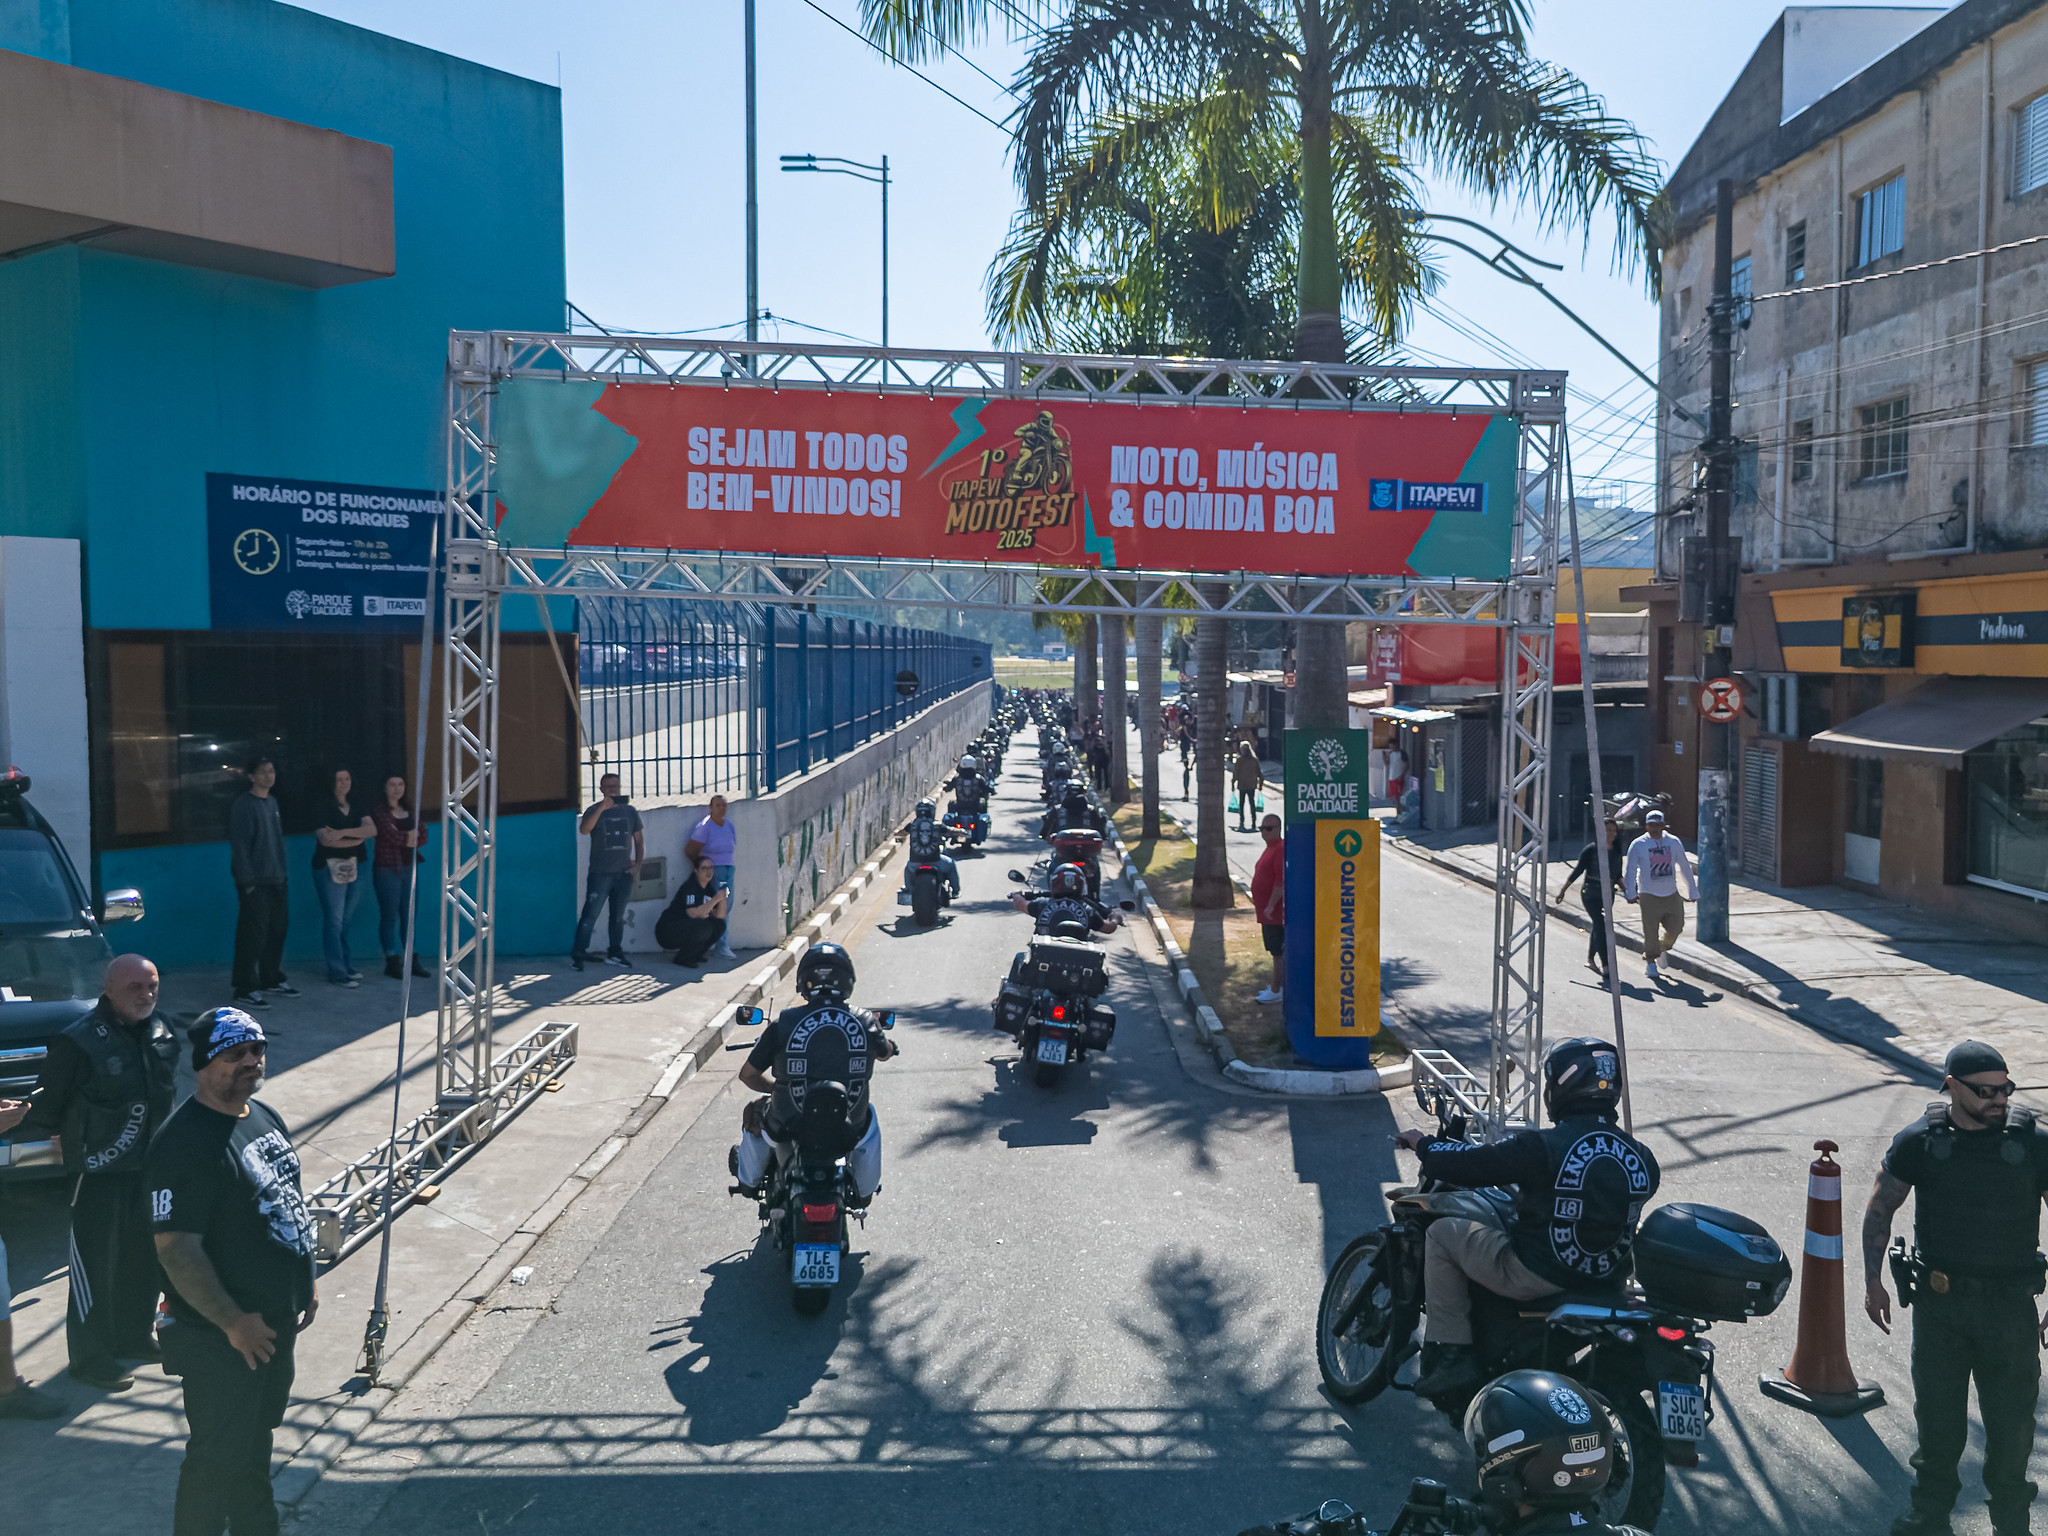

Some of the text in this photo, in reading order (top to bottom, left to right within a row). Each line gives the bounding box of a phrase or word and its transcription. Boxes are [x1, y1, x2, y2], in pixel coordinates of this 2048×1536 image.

[688, 426, 908, 473] SEJAM TODOS
[1110, 441, 1339, 492] MOTO, MÚSICA
[687, 472, 901, 518] BEM-VINDOS!
[950, 478, 1002, 500] ITAPEVI
[1409, 486, 1476, 503] ITAPEVI
[233, 485, 447, 516] HORÁRIO DE FUNCIONAMEN
[1109, 489, 1336, 534] & COMIDA BOA
[302, 508, 410, 529] DOS PARQUES
[944, 493, 1076, 535] MOTOFEST
[996, 528, 1034, 550] 2025
[312, 594, 352, 606] PARQUE
[387, 601, 423, 610] ITAPEVI
[1297, 783, 1358, 800] PARQUE
[1297, 800, 1358, 813] DACIDADE
[1340, 860, 1356, 1027] ESTACIONAMENTO
[791, 1011, 864, 1049] INSANOS
[790, 1061, 803, 1072] 18
[115, 1104, 145, 1150] PAULO
[1562, 1137, 1647, 1189] INSANOS
[152, 1189, 173, 1216] 18
[1560, 1201, 1577, 1216] 18
[806, 1251, 831, 1265] TLE
[800, 1265, 834, 1280] 6G85
[1670, 1395, 1697, 1416] SUC
[1575, 1434, 1599, 1452] agv
